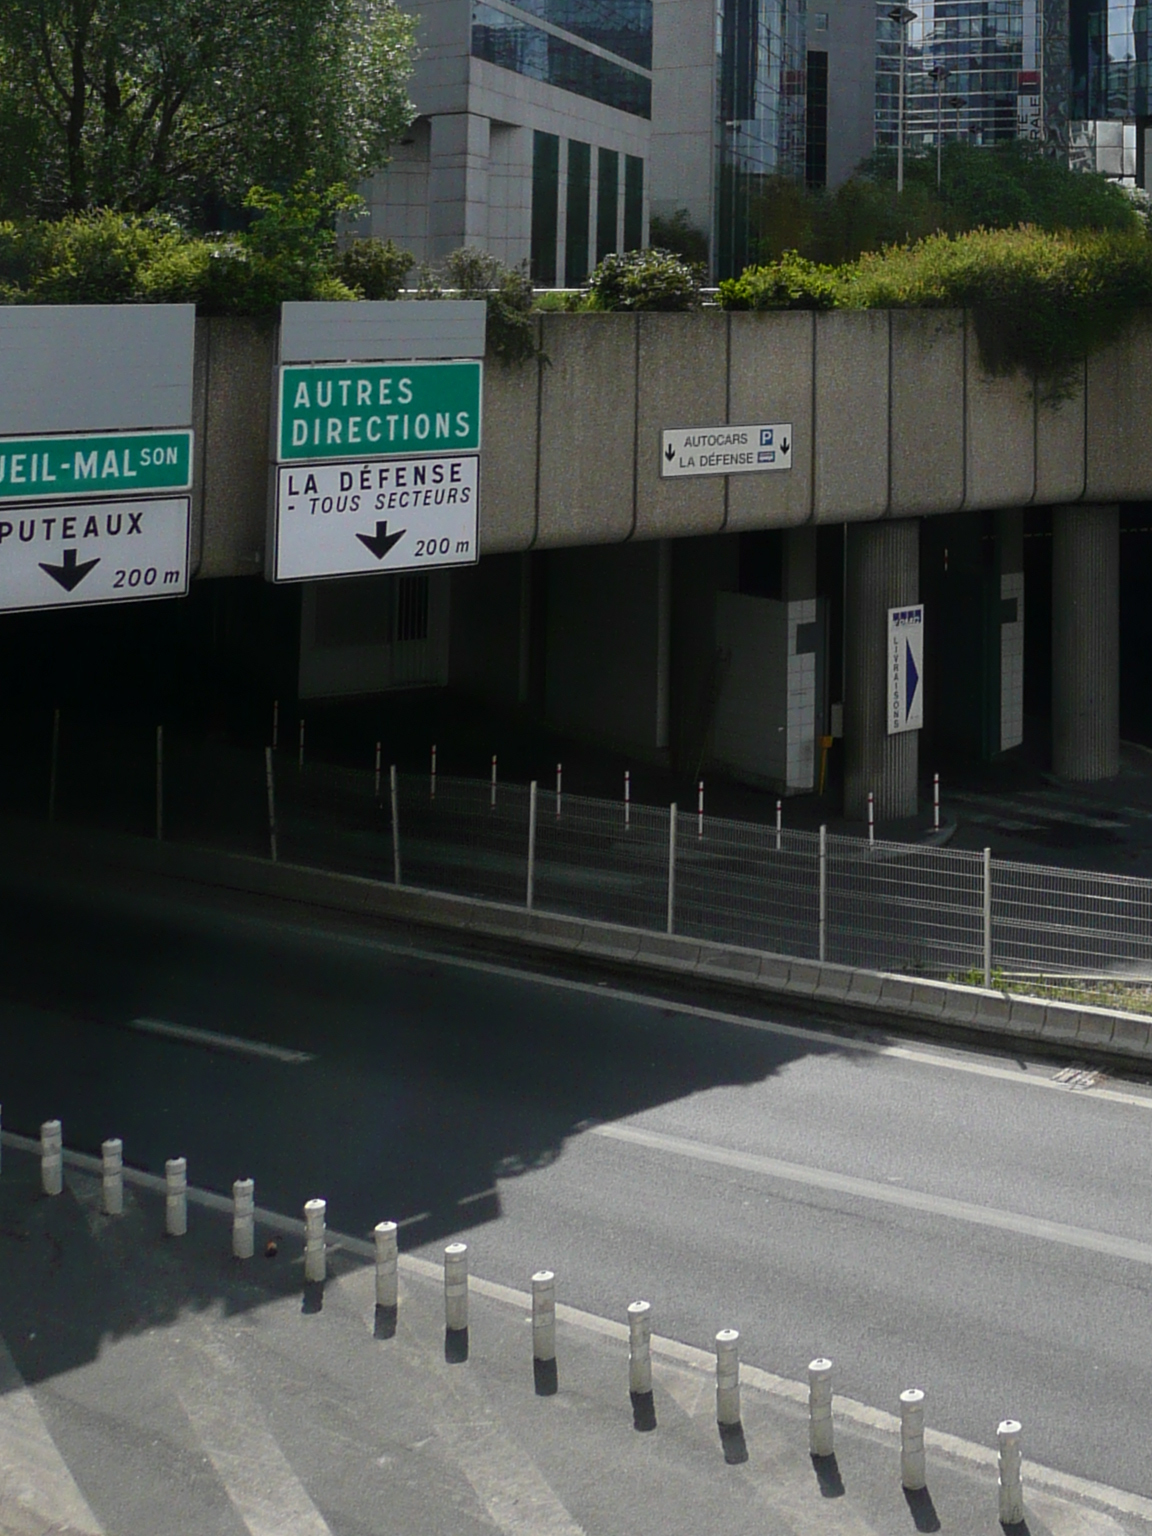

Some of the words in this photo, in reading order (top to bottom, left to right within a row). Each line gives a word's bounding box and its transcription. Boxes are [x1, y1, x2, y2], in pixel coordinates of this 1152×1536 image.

[293, 377, 413, 408] AUTRES
[292, 411, 471, 446] DIRECTIONS
[683, 432, 749, 449] AUTOCARS
[679, 456, 696, 469] LA
[699, 451, 754, 467] DÉFENSE
[288, 474, 318, 496] LA
[340, 463, 462, 492] DÉFENSE
[308, 494, 361, 515] TOUS
[374, 486, 472, 510] SECTEURS
[414, 537, 450, 557] 200
[455, 540, 470, 553] m
[112, 567, 157, 589] 200
[163, 569, 181, 584] m
[892, 636, 901, 729] LIVRAISONS
